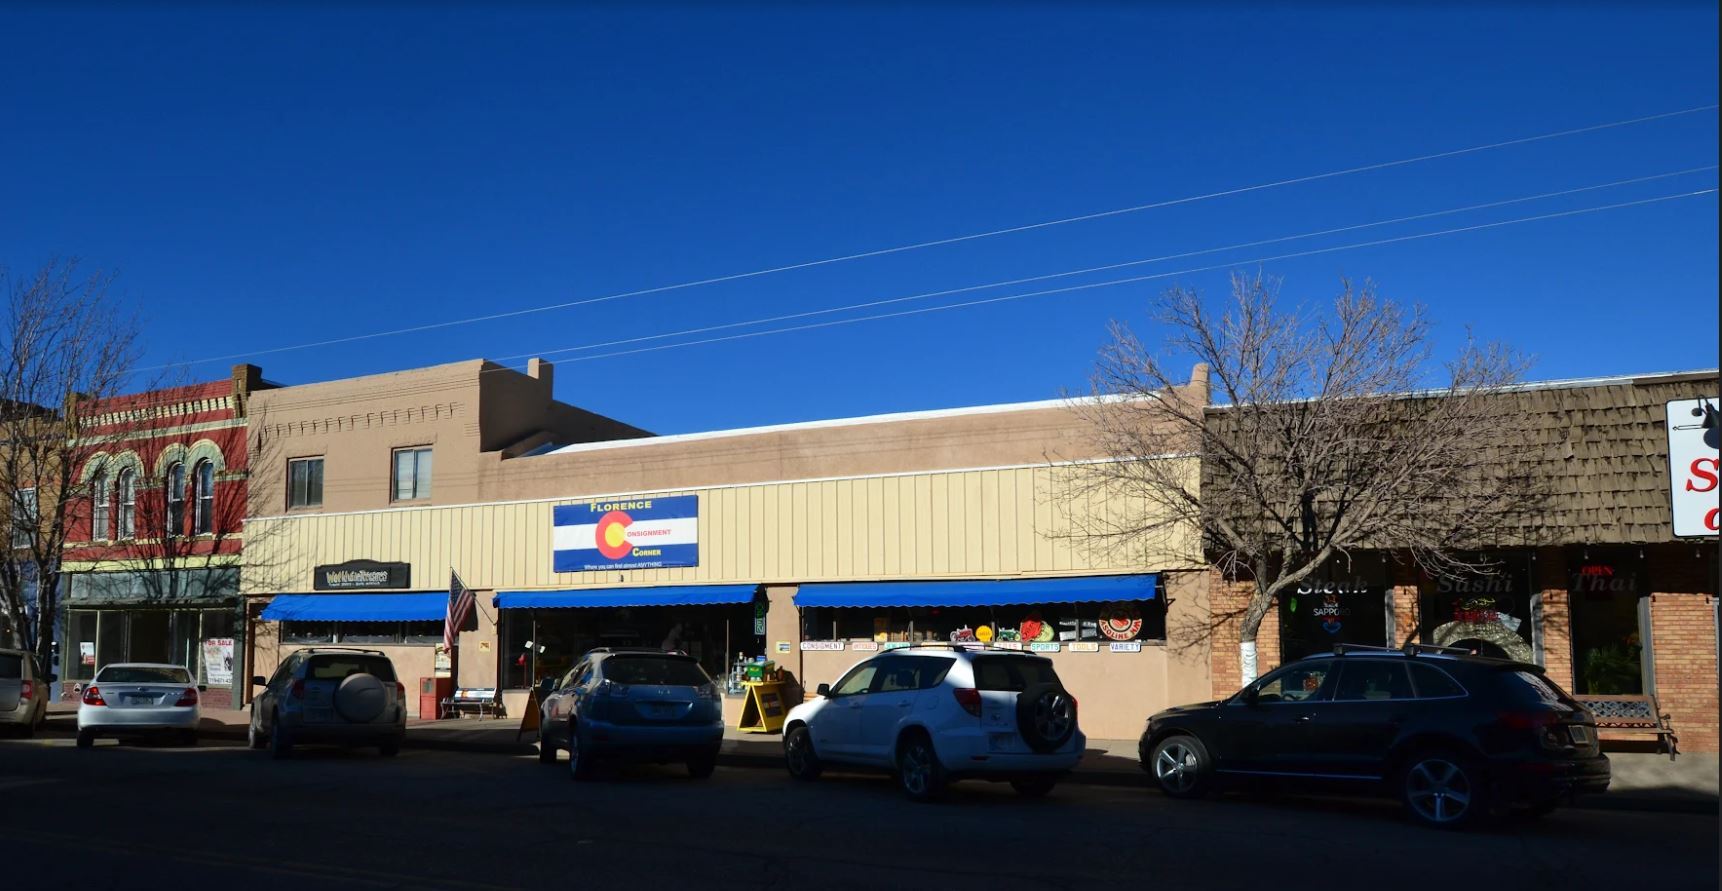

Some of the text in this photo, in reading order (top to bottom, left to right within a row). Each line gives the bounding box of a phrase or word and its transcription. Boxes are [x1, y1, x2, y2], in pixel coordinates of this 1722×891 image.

[590, 501, 652, 512] FLORENCE
[632, 547, 662, 557] CORNER
[1297, 576, 1368, 595] Steak
[1437, 572, 1513, 592] Sushi
[1572, 573, 1638, 592] Thai
[1031, 642, 1059, 650] SPORTS
[1072, 642, 1097, 650] TOOLS
[1110, 642, 1140, 650] VARIETY
